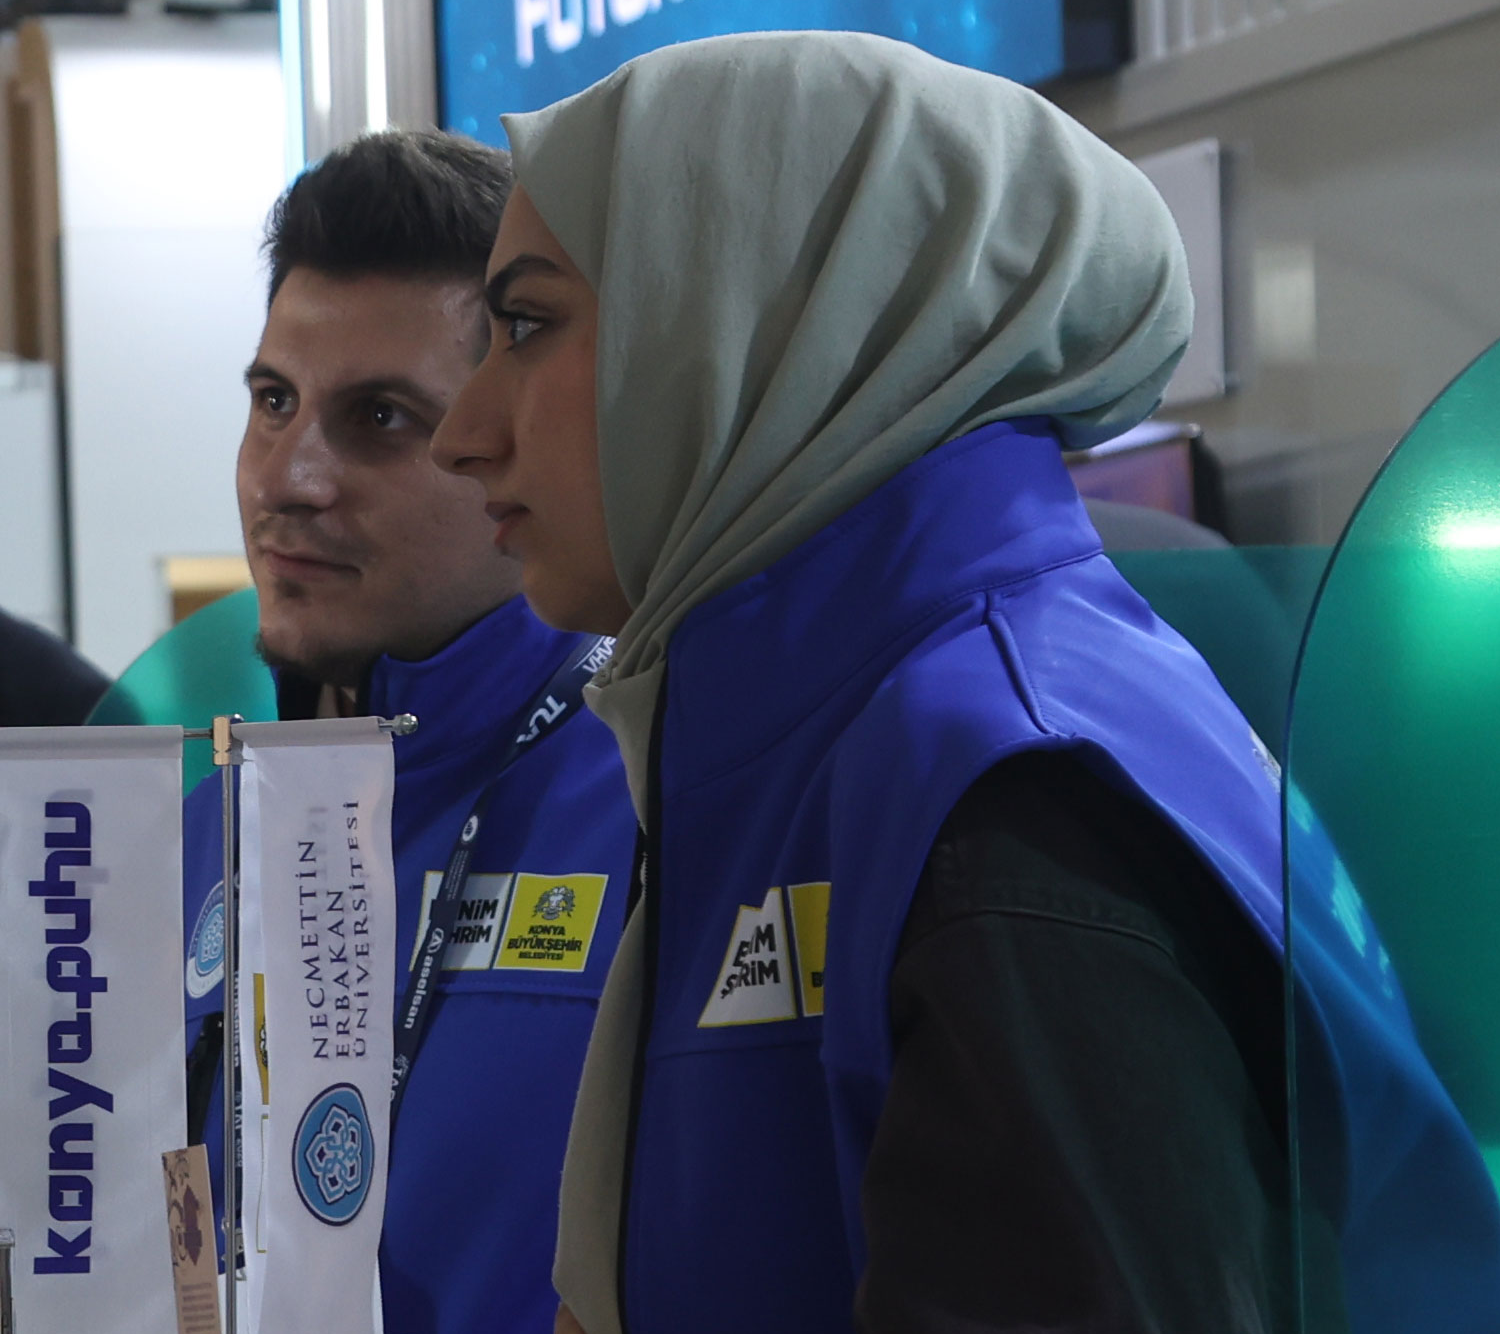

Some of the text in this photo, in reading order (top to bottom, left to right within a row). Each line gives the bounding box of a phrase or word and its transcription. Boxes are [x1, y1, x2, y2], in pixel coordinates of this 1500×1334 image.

[295, 840, 329, 1059] NECMETTİN
[326, 890, 350, 1058] ERBAKAN
[343, 800, 370, 1058] ÜNİVERSİTESİ
[404, 955, 434, 1029] aselsan
[528, 925, 566, 936] KONYA
